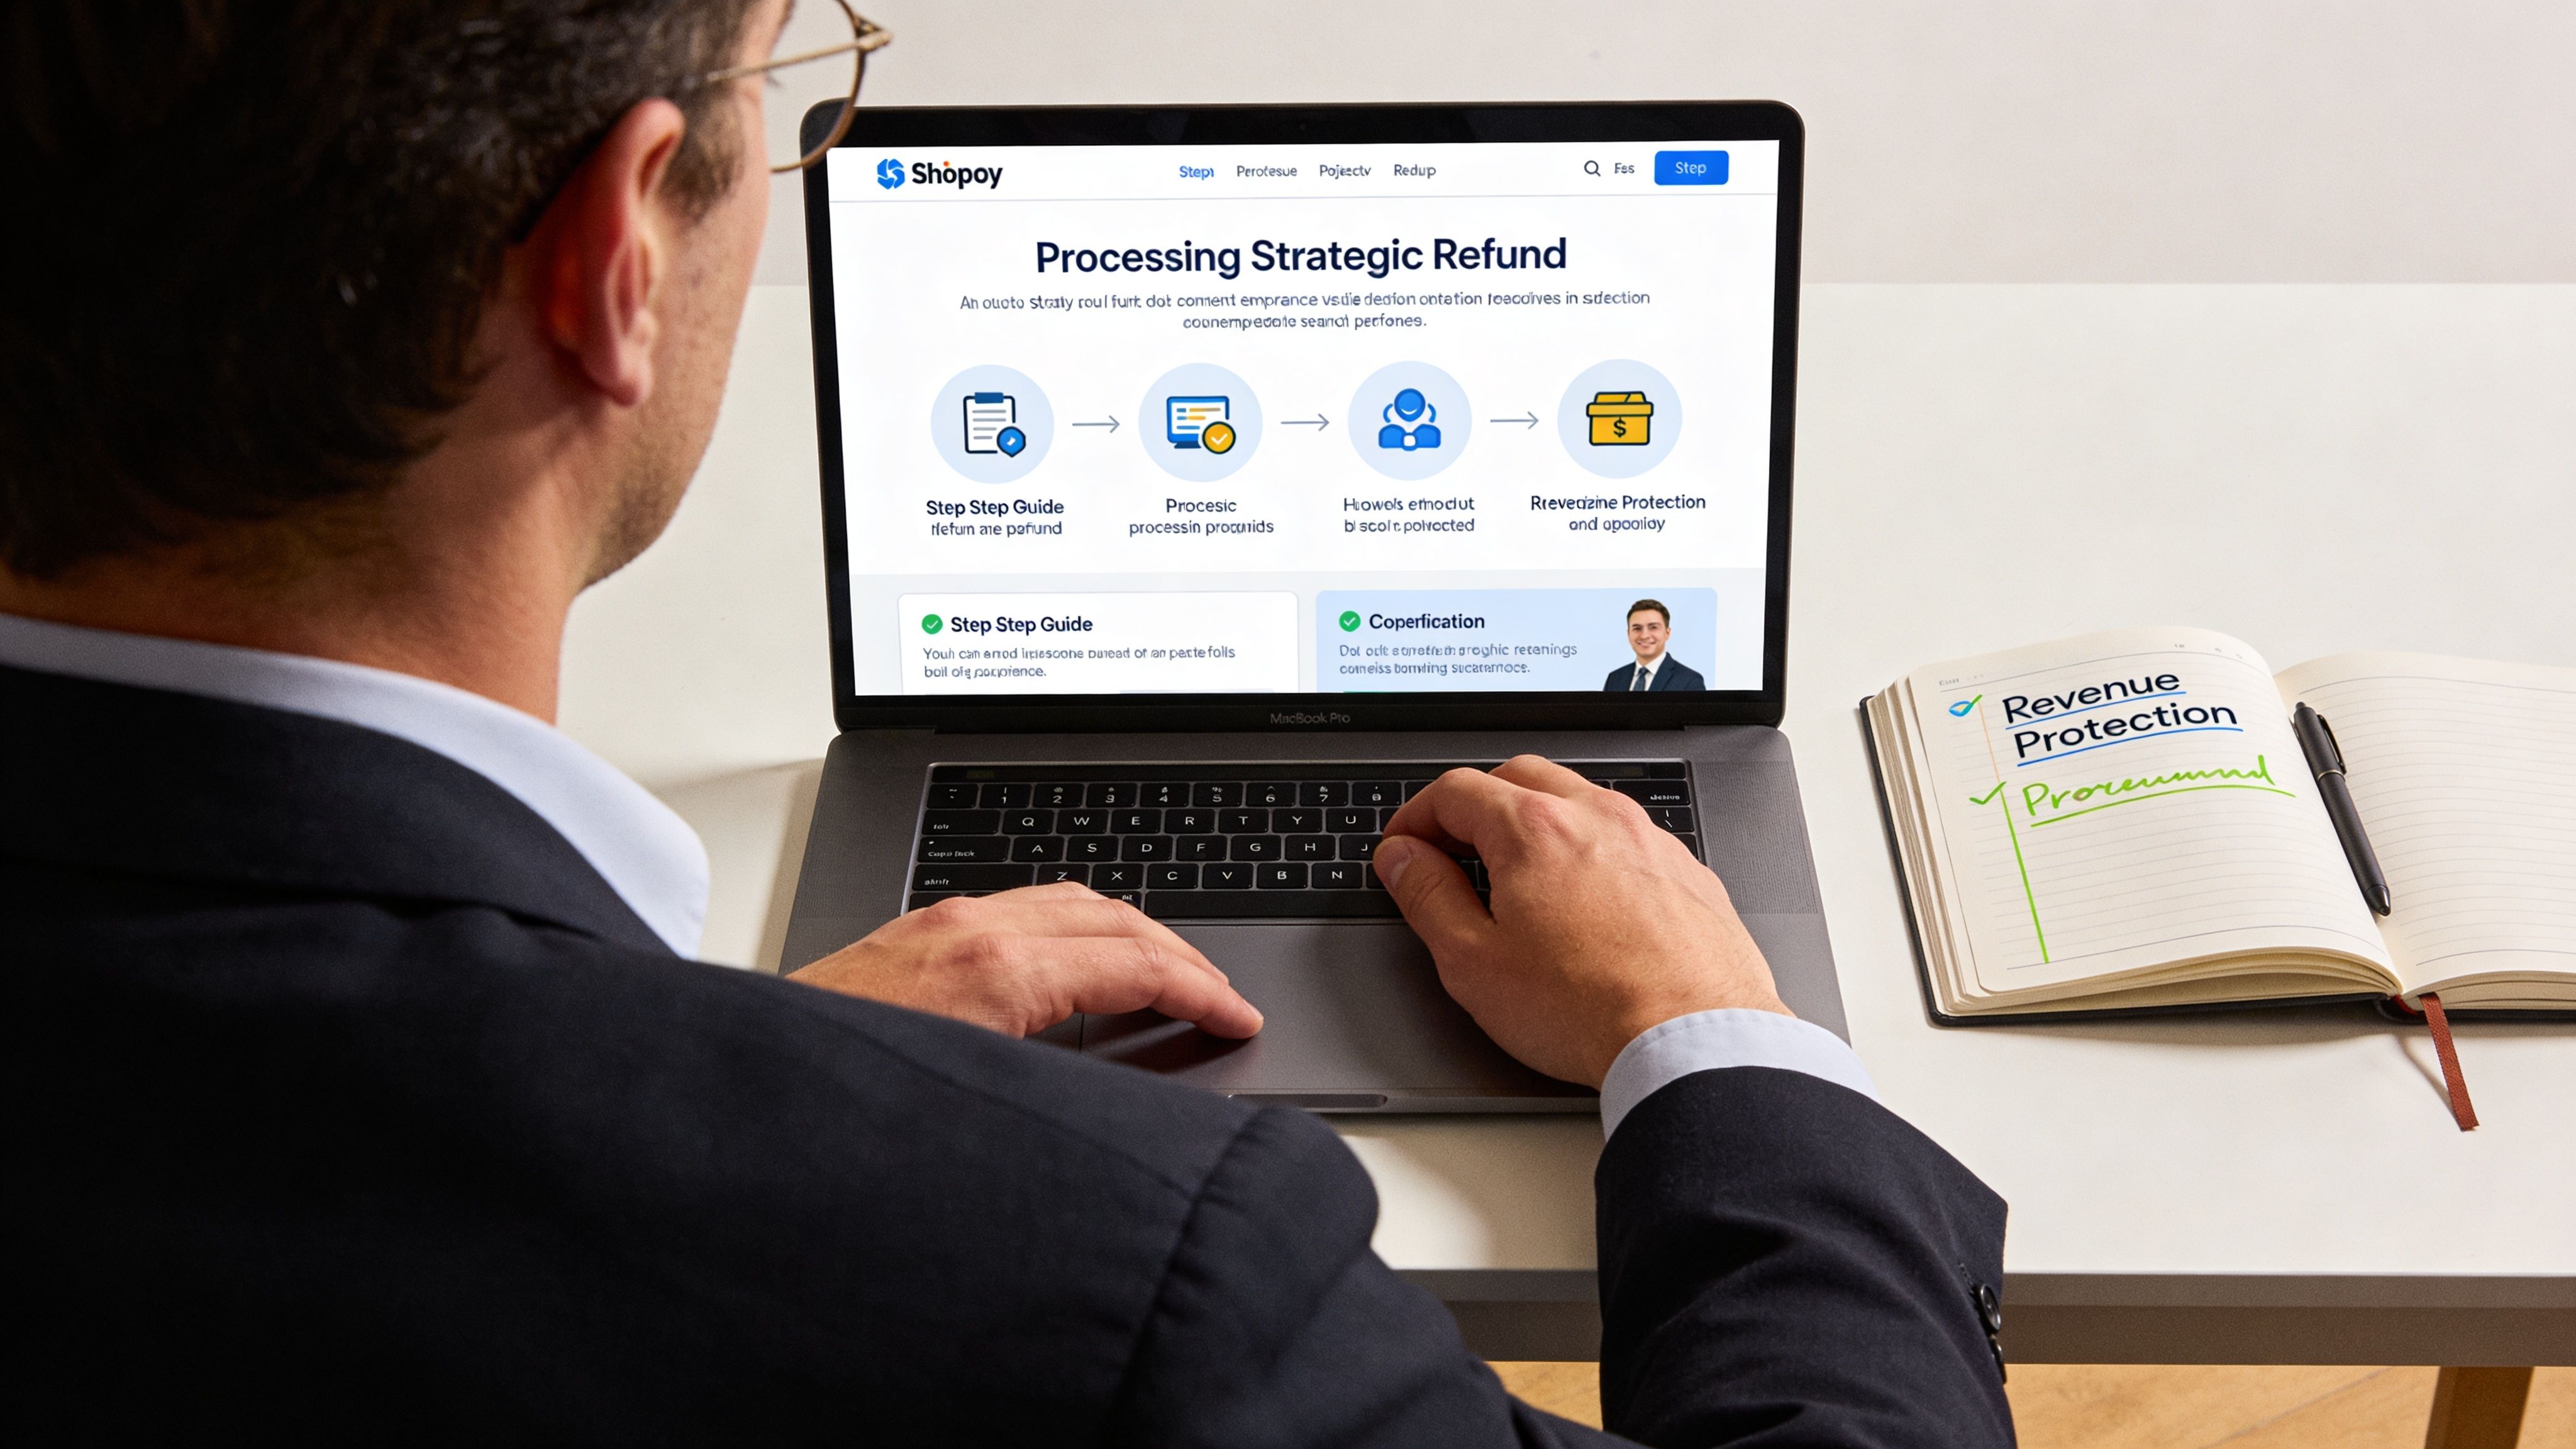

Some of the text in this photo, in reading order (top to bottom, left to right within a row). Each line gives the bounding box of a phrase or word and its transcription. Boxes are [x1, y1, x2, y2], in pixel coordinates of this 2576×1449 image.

[1675, 161, 1707, 177] Step
[911, 161, 1004, 190] Shopoy
[1036, 236, 1567, 280] Processing Strategic Refund
[1566, 291, 1579, 305] in
[1622, 494, 1706, 509] Protection
[926, 499, 1065, 519] Step Step Guide
[950, 615, 1094, 636] Step Step Guide
[1369, 613, 1485, 631] Coperfication
[2002, 674, 2180, 724] Revenue
[1270, 712, 1351, 724] MacBook Pro
[2014, 701, 2238, 759] Protection
[1053, 795, 1062, 804] 2
[1265, 794, 1275, 802] 6
[1319, 794, 1328, 802] 7
[1022, 817, 1035, 827] Q
[1074, 817, 1090, 826] W
[1131, 816, 1140, 825] E
[1185, 816, 1195, 825] R
[1238, 816, 1248, 825] T
[1292, 816, 1302, 825] Y
[1345, 815, 1357, 824] U
[1031, 845, 1043, 853] A
[1087, 843, 1097, 853] S
[1141, 843, 1153, 852] D
[1196, 843, 1206, 852] F
[1250, 843, 1262, 852] G
[1304, 843, 1316, 852] H
[1361, 843, 1368, 852] J
[1057, 871, 1068, 881] Z
[1111, 871, 1123, 880] X
[1167, 871, 1178, 880] C
[1222, 871, 1233, 880] V
[1277, 870, 1287, 880] B
[1331, 870, 1343, 879] N
